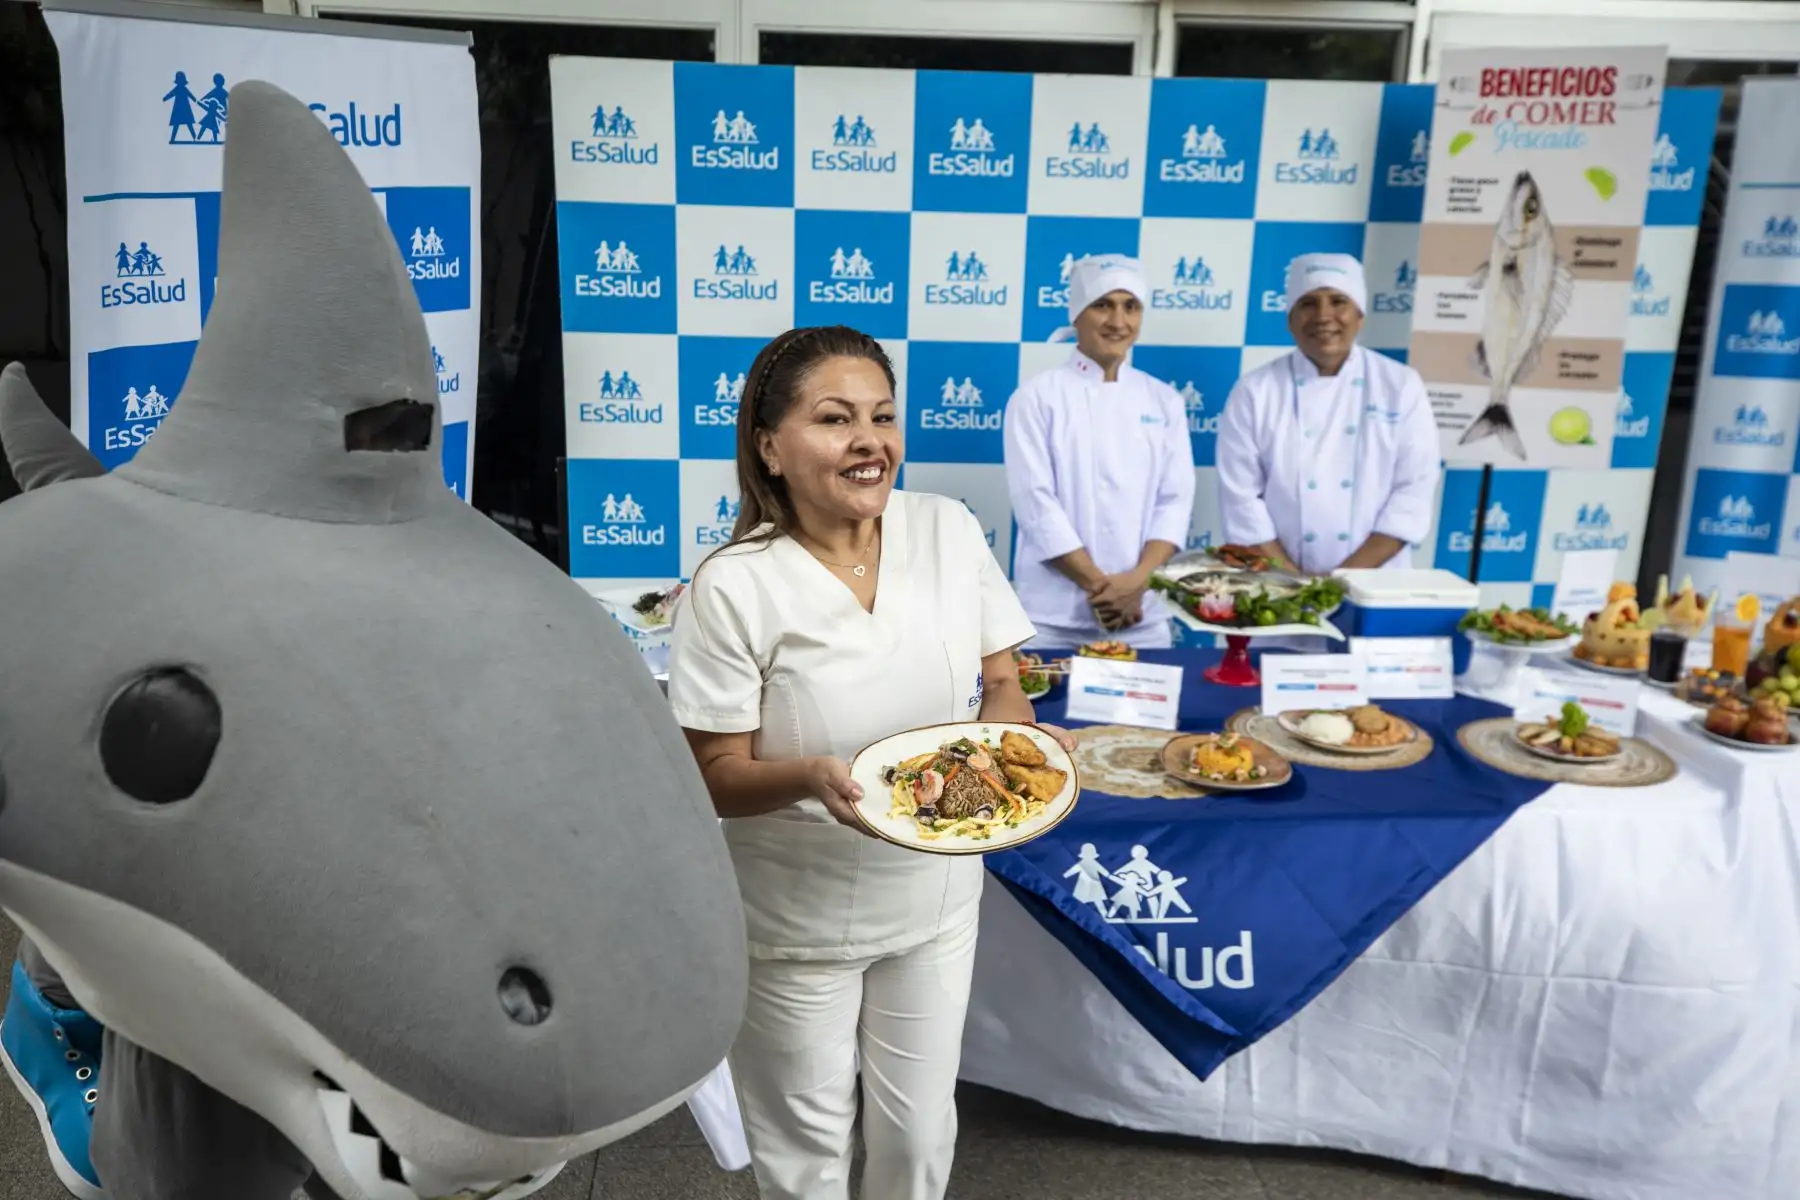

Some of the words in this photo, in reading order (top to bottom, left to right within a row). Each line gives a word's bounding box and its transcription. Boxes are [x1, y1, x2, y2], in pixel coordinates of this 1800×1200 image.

[1480, 66, 1618, 97] BENEFICIOS
[308, 101, 401, 147] alud
[1470, 104, 1498, 125] de
[1506, 101, 1617, 126] COMER
[571, 141, 658, 165] EsSalud
[692, 145, 779, 170] EsSalud
[812, 149, 896, 173] EsSalud
[929, 153, 1014, 177] EsSalud
[1046, 157, 1129, 179] EsSalud
[1159, 159, 1245, 183] EsSalud
[1275, 163, 1357, 184] EsSalud
[407, 256, 460, 280] sSalud
[101, 278, 186, 308] EsSalud
[575, 274, 661, 298] EsSalud
[694, 278, 778, 300] EsSalud
[810, 281, 894, 304] EsSalud
[925, 285, 1008, 306] EsSalud
[1151, 289, 1233, 310] EsSalud
[580, 403, 662, 423] EsSalud
[920, 408, 1002, 431] EsSalud
[583, 525, 664, 545] EsSalud
